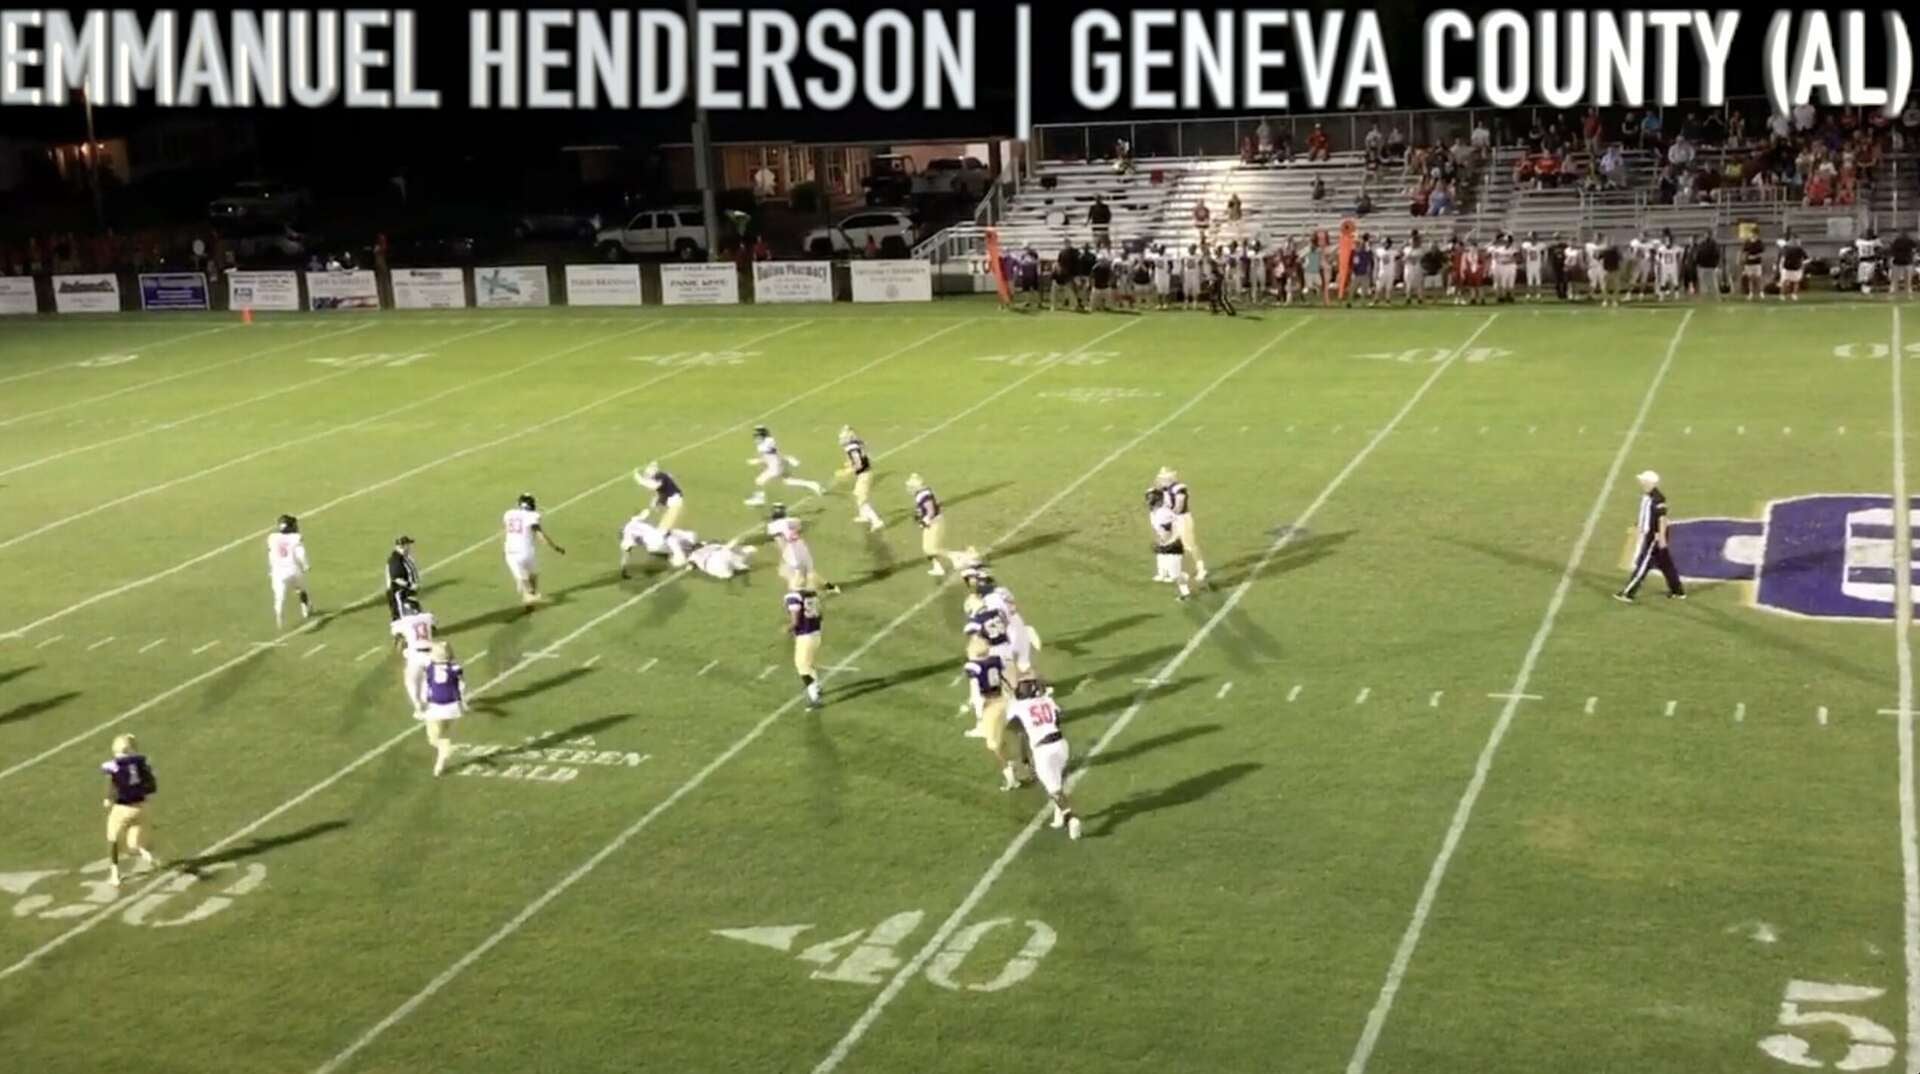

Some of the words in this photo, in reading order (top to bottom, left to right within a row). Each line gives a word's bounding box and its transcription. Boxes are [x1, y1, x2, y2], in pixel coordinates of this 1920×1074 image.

[1029, 702, 1053, 727] 50
[13, 855, 267, 928] 30
[795, 909, 1057, 992] 40
[1756, 979, 1897, 1071] 5
